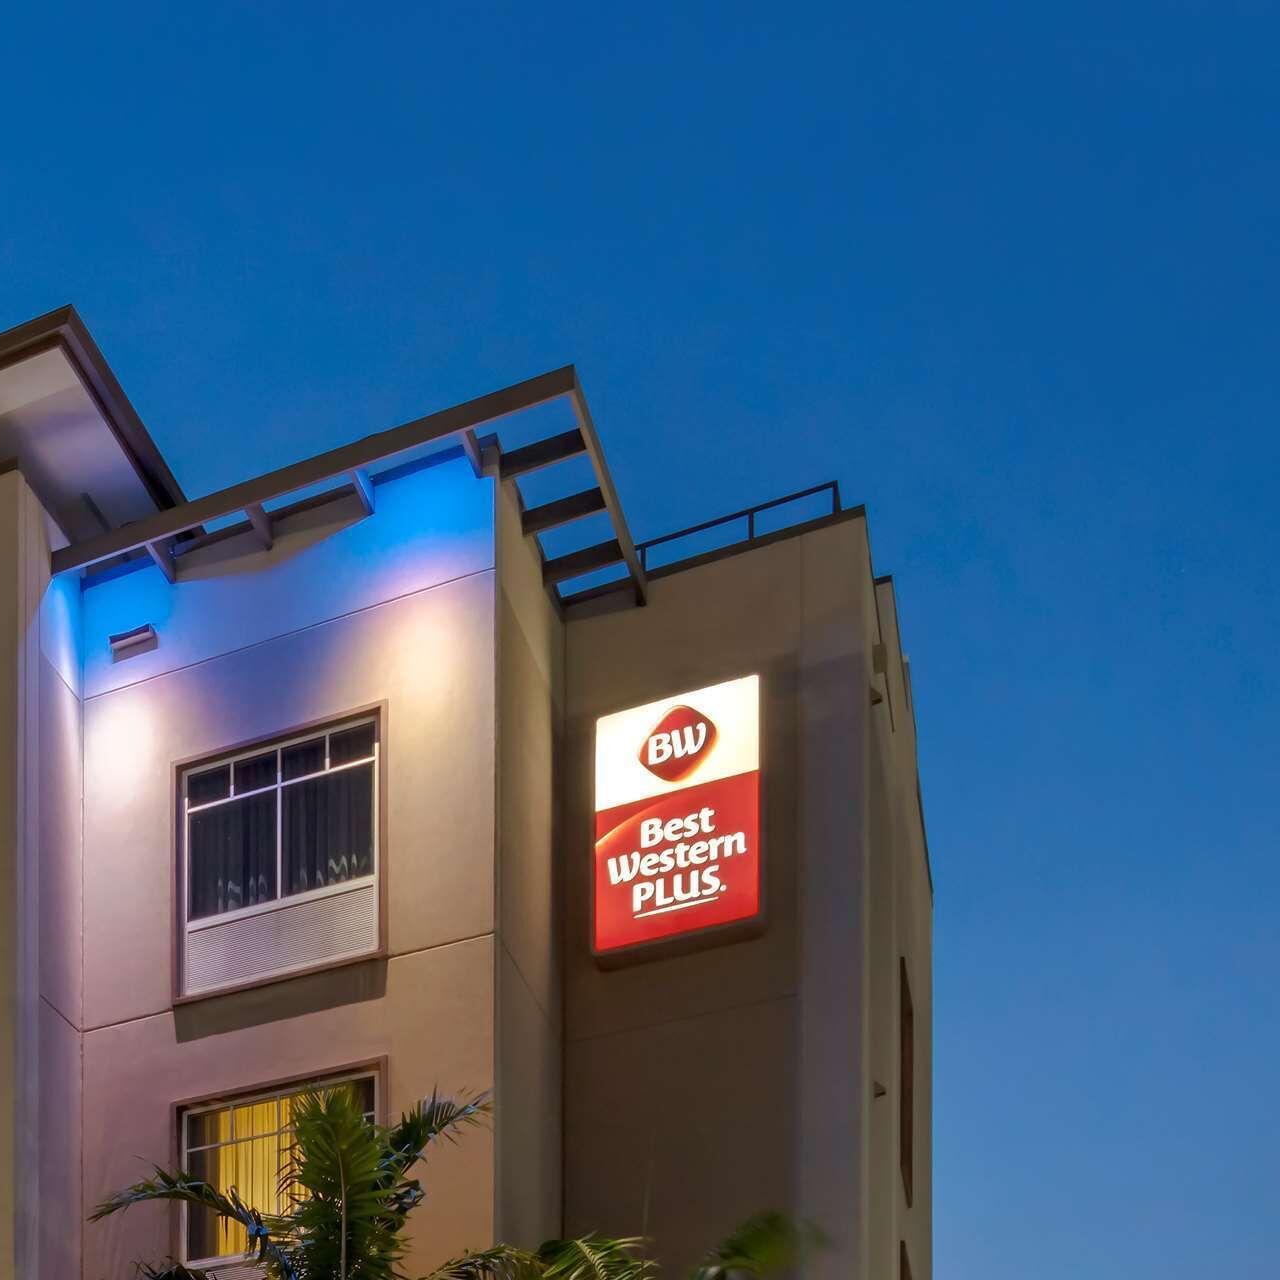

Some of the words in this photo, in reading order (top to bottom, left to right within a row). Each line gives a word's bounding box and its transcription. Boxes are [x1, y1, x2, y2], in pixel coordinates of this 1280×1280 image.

[648, 722, 707, 765] BW
[641, 807, 715, 848] Best
[607, 831, 747, 885] Western
